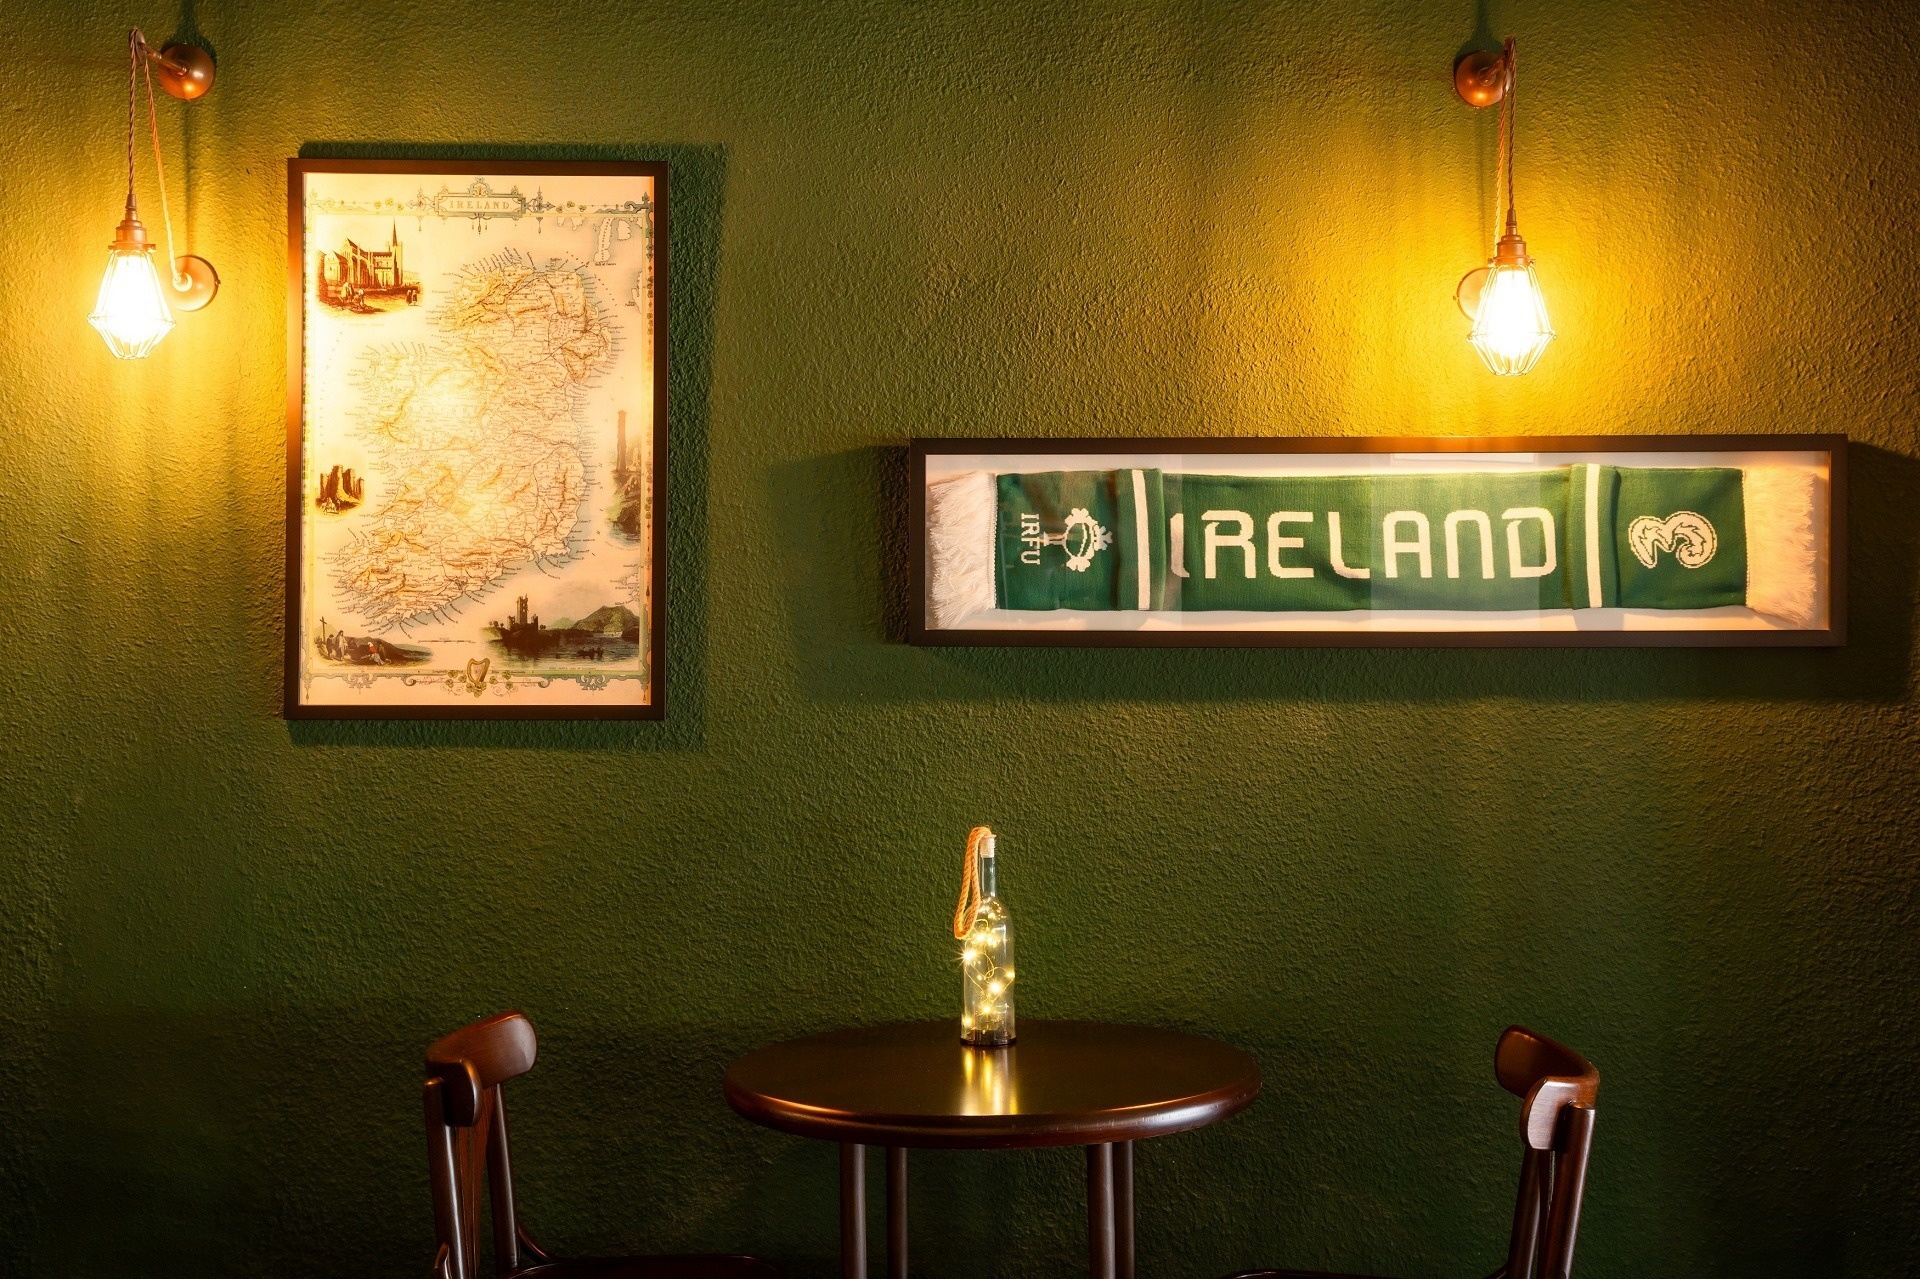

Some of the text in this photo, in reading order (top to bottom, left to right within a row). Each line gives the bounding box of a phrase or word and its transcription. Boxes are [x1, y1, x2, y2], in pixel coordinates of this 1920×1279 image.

[449, 201, 510, 210] IRELAND
[1020, 513, 1041, 565] IRFU
[1169, 508, 1557, 579] IRELAND
